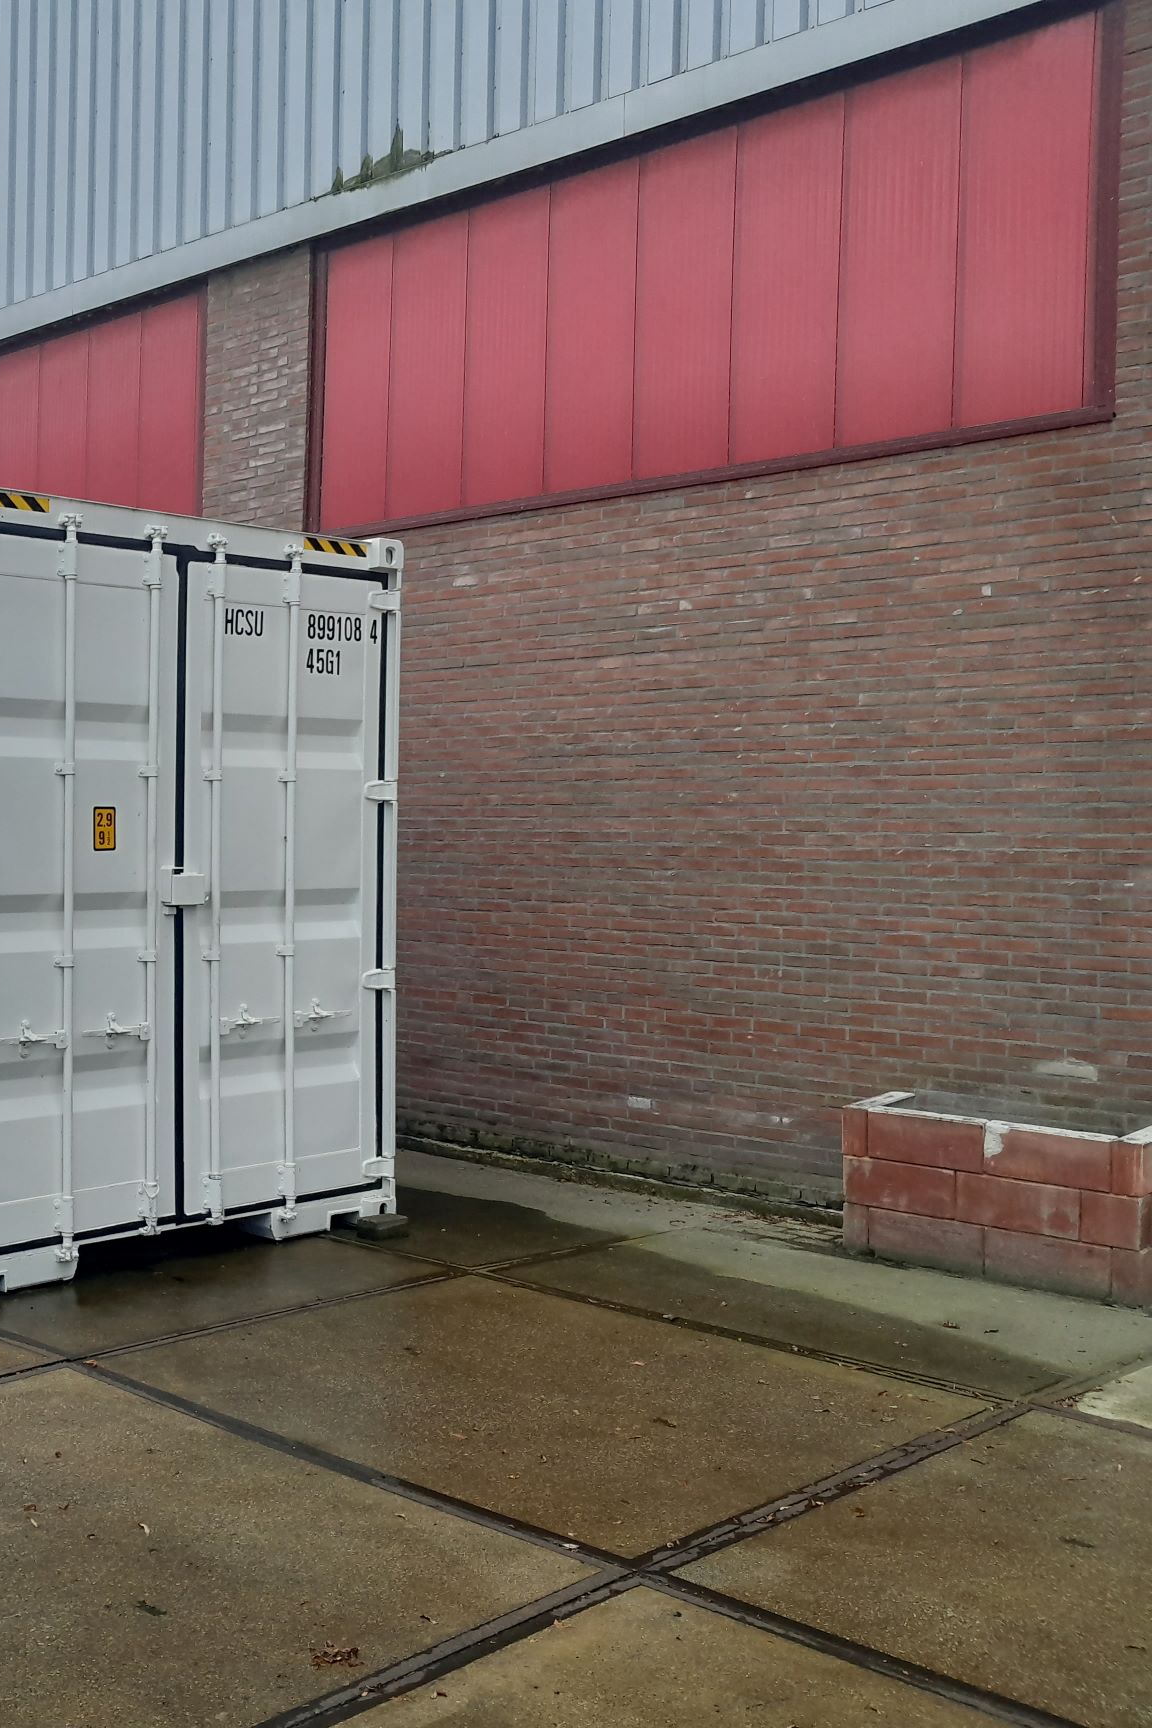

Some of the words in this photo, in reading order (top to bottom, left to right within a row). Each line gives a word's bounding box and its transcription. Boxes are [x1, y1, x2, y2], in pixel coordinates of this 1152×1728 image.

[224, 608, 264, 637] HCSU
[307, 614, 362, 642] 899108
[369, 619, 378, 645] 4
[306, 648, 341, 676] 45G1
